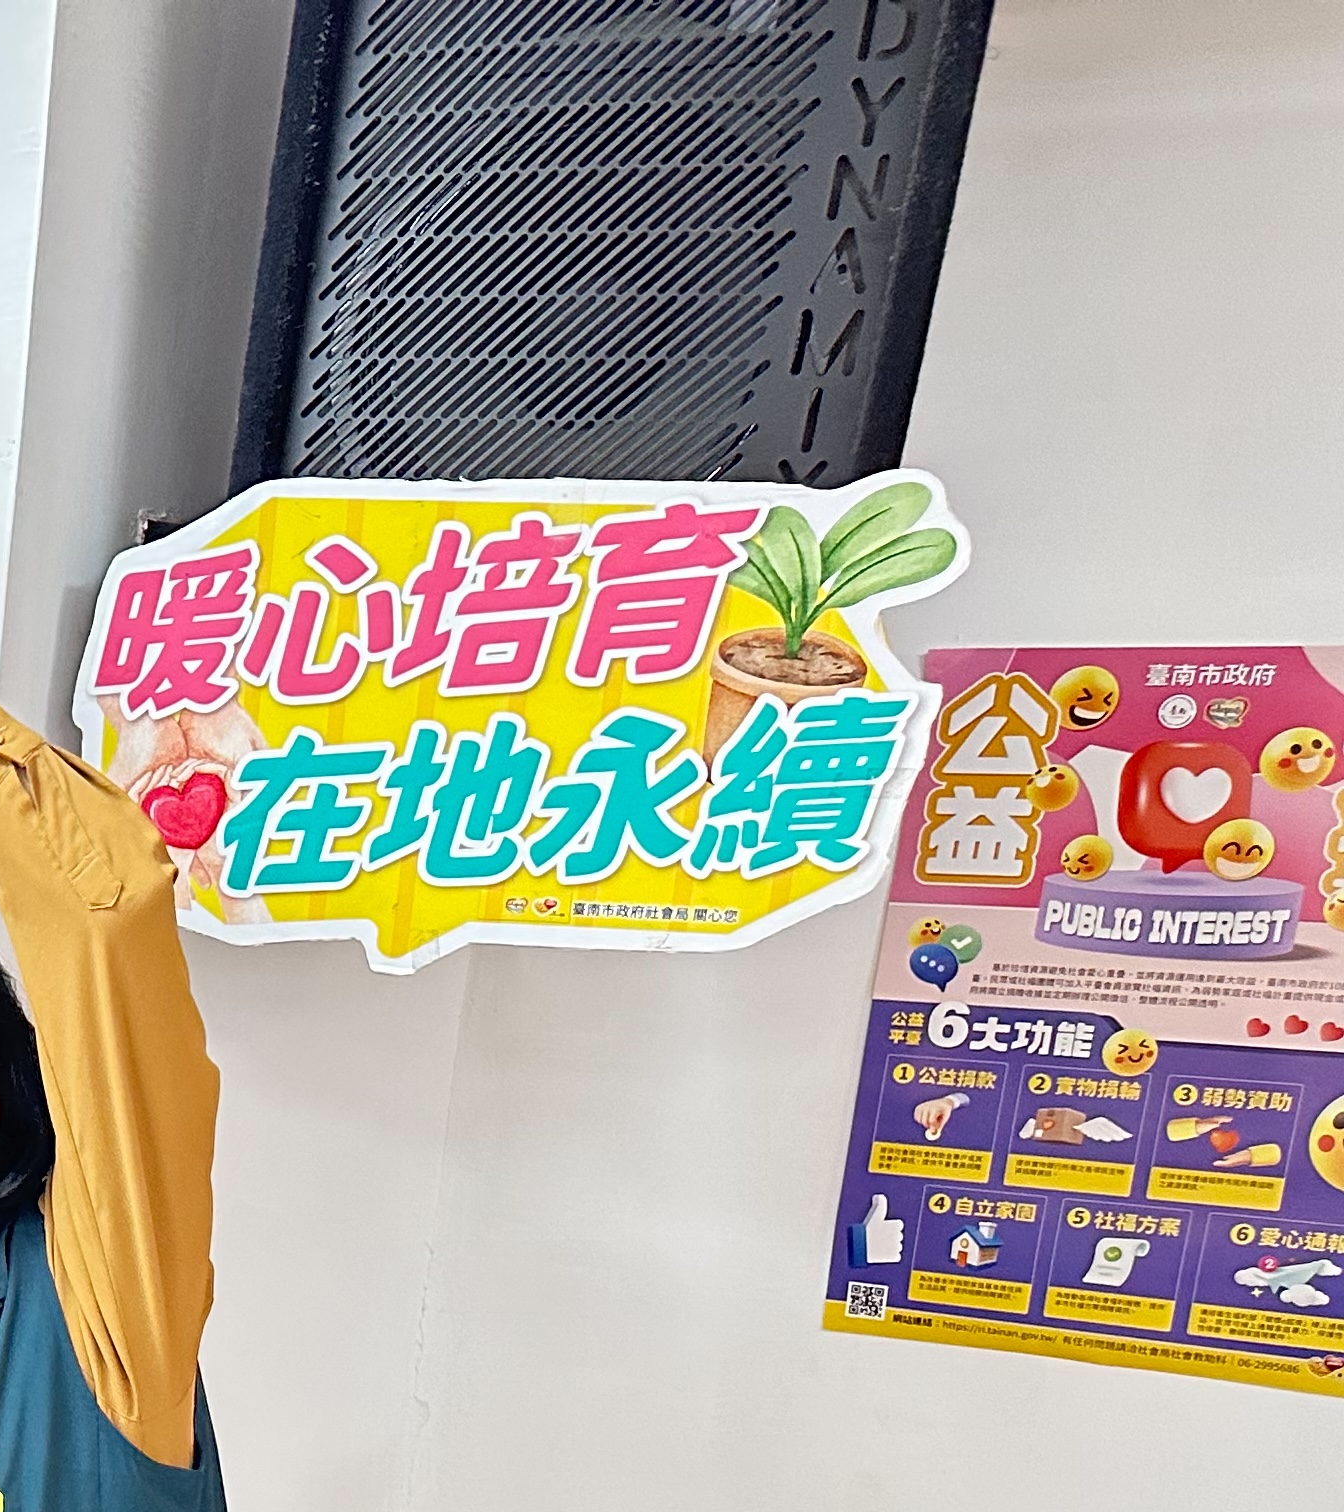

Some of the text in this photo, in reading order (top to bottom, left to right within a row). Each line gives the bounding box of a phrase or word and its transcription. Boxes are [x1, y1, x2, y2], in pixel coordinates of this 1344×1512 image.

[95, 503, 769, 712] 暖心培育
[1145, 663, 1277, 687] 臺南市政府
[922, 681, 1049, 877] 公益
[224, 694, 911, 894] 在地永續
[1043, 900, 1291, 946] PUBLIC INTEREST
[891, 1011, 925, 1028] 公益
[928, 1001, 1095, 1059] 6大功能
[889, 1030, 922, 1046] 平臺
[919, 1067, 997, 1090] 公益捐款
[1201, 1087, 1293, 1113] 弱勢資助
[955, 1197, 1038, 1222] 自立家園
[1094, 1211, 1182, 1237] 社福方案
